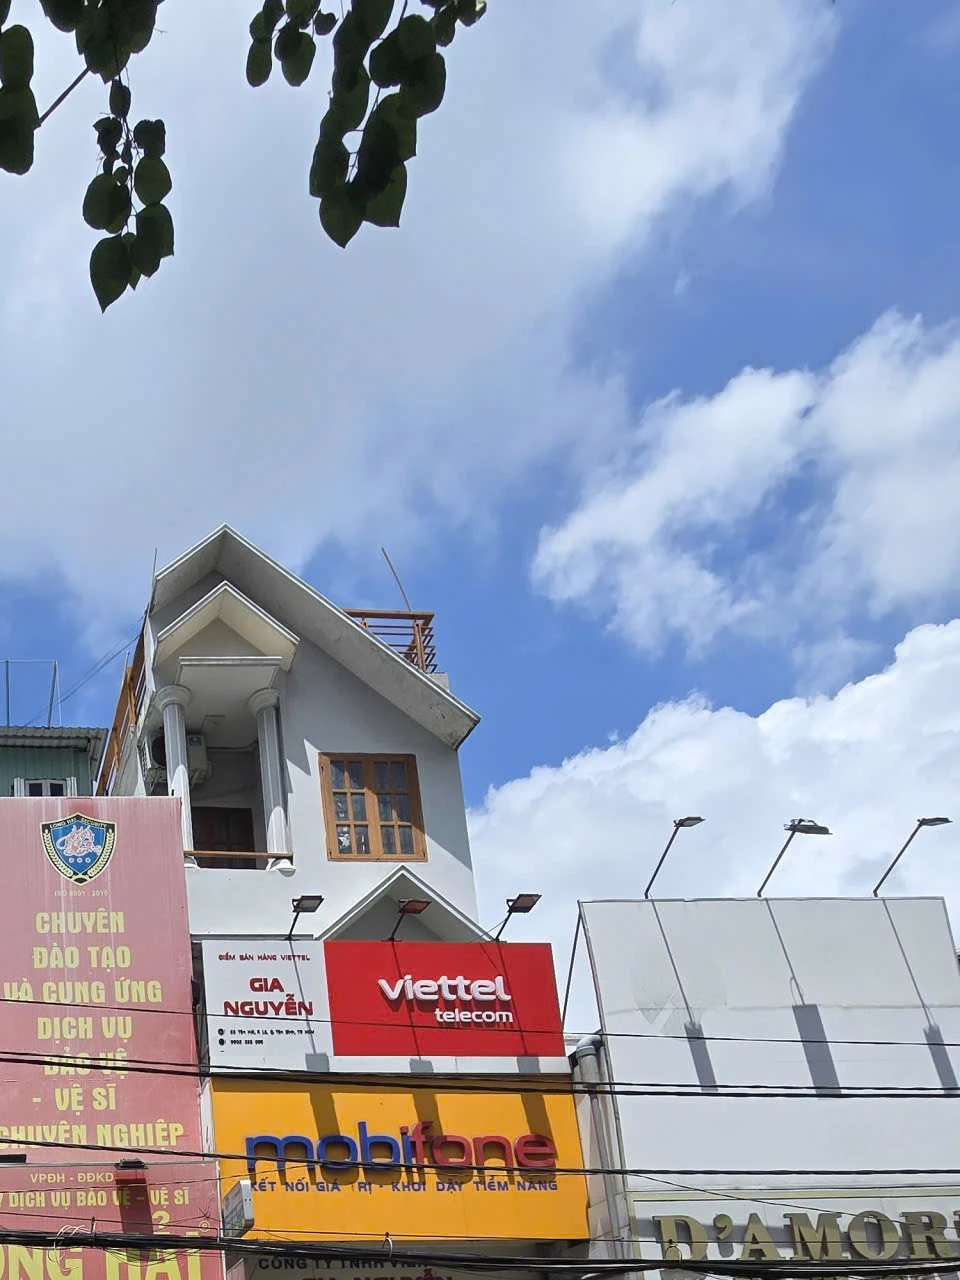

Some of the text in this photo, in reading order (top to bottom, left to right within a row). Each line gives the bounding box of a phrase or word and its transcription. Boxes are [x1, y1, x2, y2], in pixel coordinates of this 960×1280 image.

[35, 907, 125, 934] CHUYÊN
[32, 944, 131, 974] ĐÀO TẠO
[3, 977, 163, 1004] VÀ CUNG ỨNG
[249, 977, 285, 992] GIA
[377, 975, 512, 1002] viettel
[223, 993, 314, 1016] NGUYỄN
[433, 1008, 514, 1023] telecom
[37, 1016, 133, 1045] DỊCH VỤ
[54, 1084, 117, 1117] VỆ SĨ
[96, 1118, 184, 1152] NGHIỆP
[245, 1120, 555, 1170] mobifone
[30, 1172, 114, 1184] VPĐH ĐĐKD
[251, 1176, 277, 1192] KẾT
[285, 1177, 309, 1192] NỐI
[315, 1178, 341, 1192] GIÁ
[436, 1179, 464, 1194] DẬY
[473, 1175, 509, 1192] TIỀM
[8, 1191, 46, 1211] DỊCH
[50, 1190, 71, 1210] VỤ
[76, 1187, 107, 1207] BẢO
[112, 1186, 132, 1208] VỆ
[149, 1186, 170, 1209] VỆ
[174, 1186, 190, 1205] SĨ
[652, 1209, 960, 1260] D'AMOR
[258, 1255, 334, 1270] CÔNG TY
